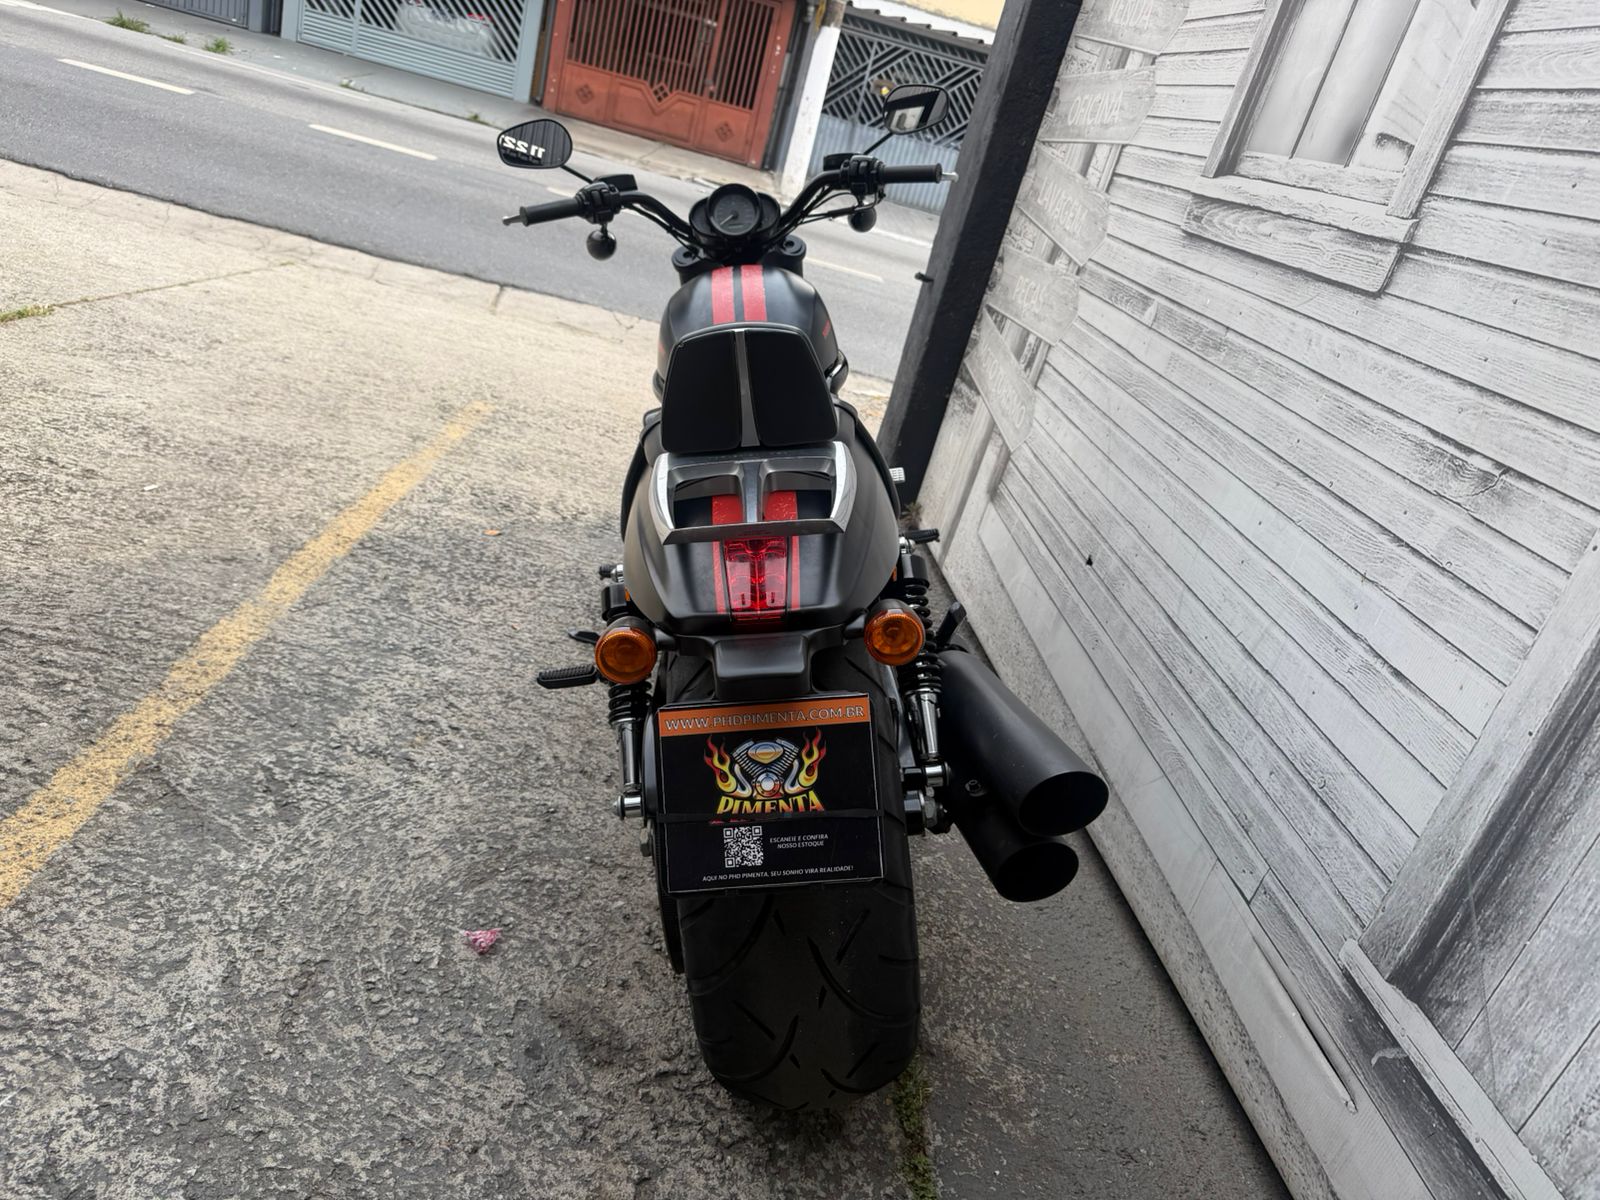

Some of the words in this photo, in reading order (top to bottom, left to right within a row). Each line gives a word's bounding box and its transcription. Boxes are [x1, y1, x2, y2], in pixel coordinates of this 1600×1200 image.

[1069, 92, 1123, 125] OFICINA
[1038, 178, 1087, 234] LAVAGEM
[1013, 275, 1048, 314] PEÇAS
[665, 706, 865, 731] WWW.PHDPIMENTA.COM.BR
[716, 791, 825, 815] PIMENTA
[769, 836, 797, 844] ESCANEIE
[802, 833, 829, 841] CONFIRA
[797, 840, 824, 849] ESTOQUE
[819, 865, 854, 873] REALIDADE!
